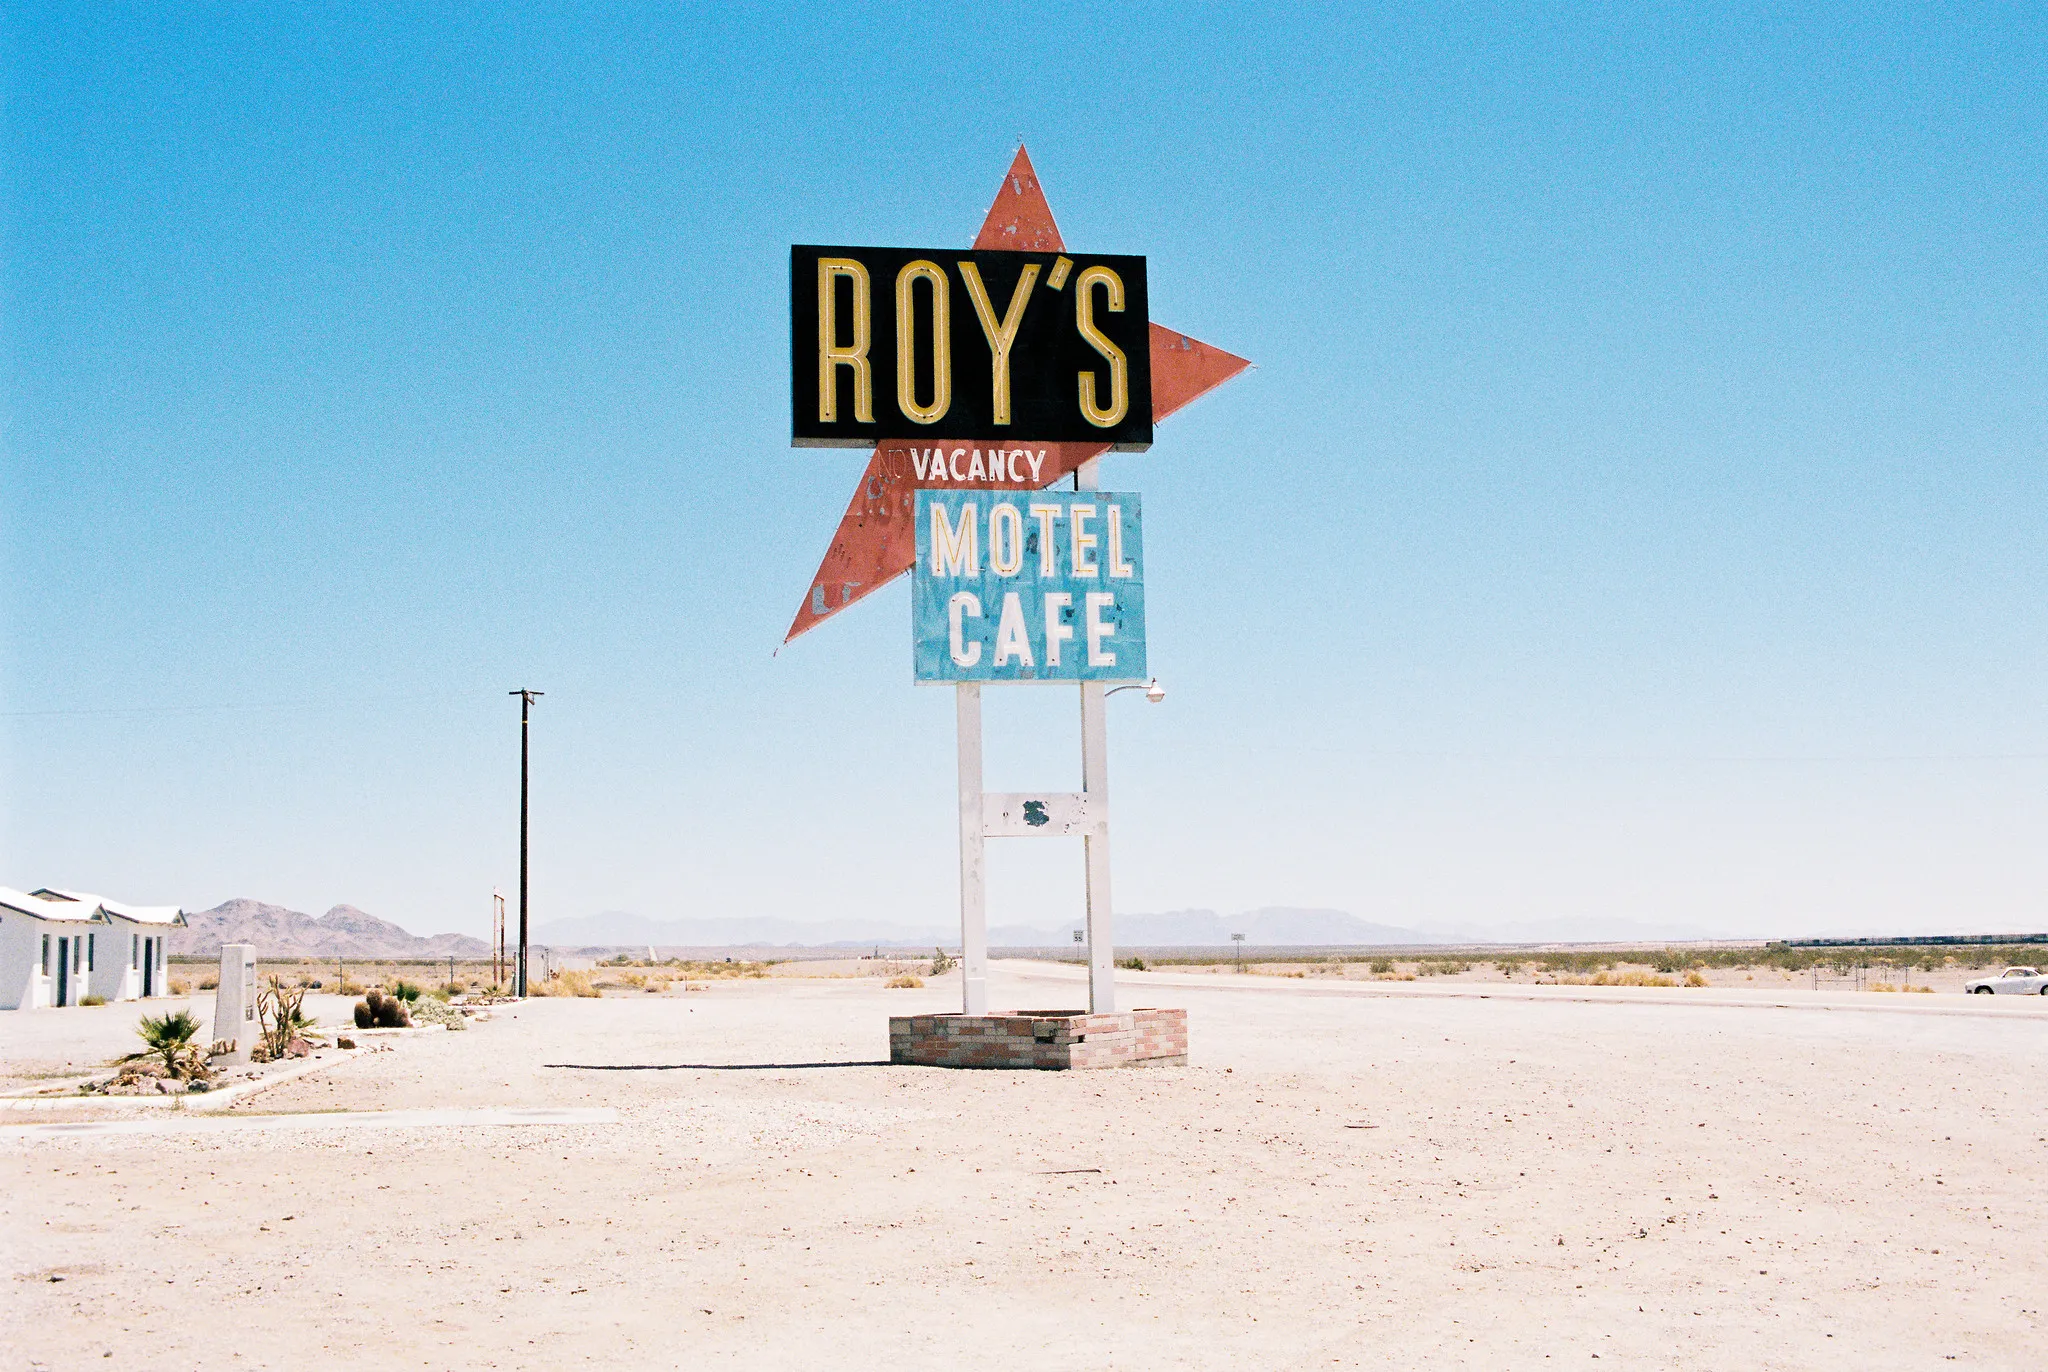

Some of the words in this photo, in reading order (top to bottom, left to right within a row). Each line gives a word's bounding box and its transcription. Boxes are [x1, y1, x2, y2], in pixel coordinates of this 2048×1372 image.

[818, 256, 1129, 428] ROY'S
[877, 449, 907, 478] NO
[910, 448, 1046, 482] VACANCY
[930, 502, 1132, 577] MOTEL
[948, 591, 1116, 667] CAFE
